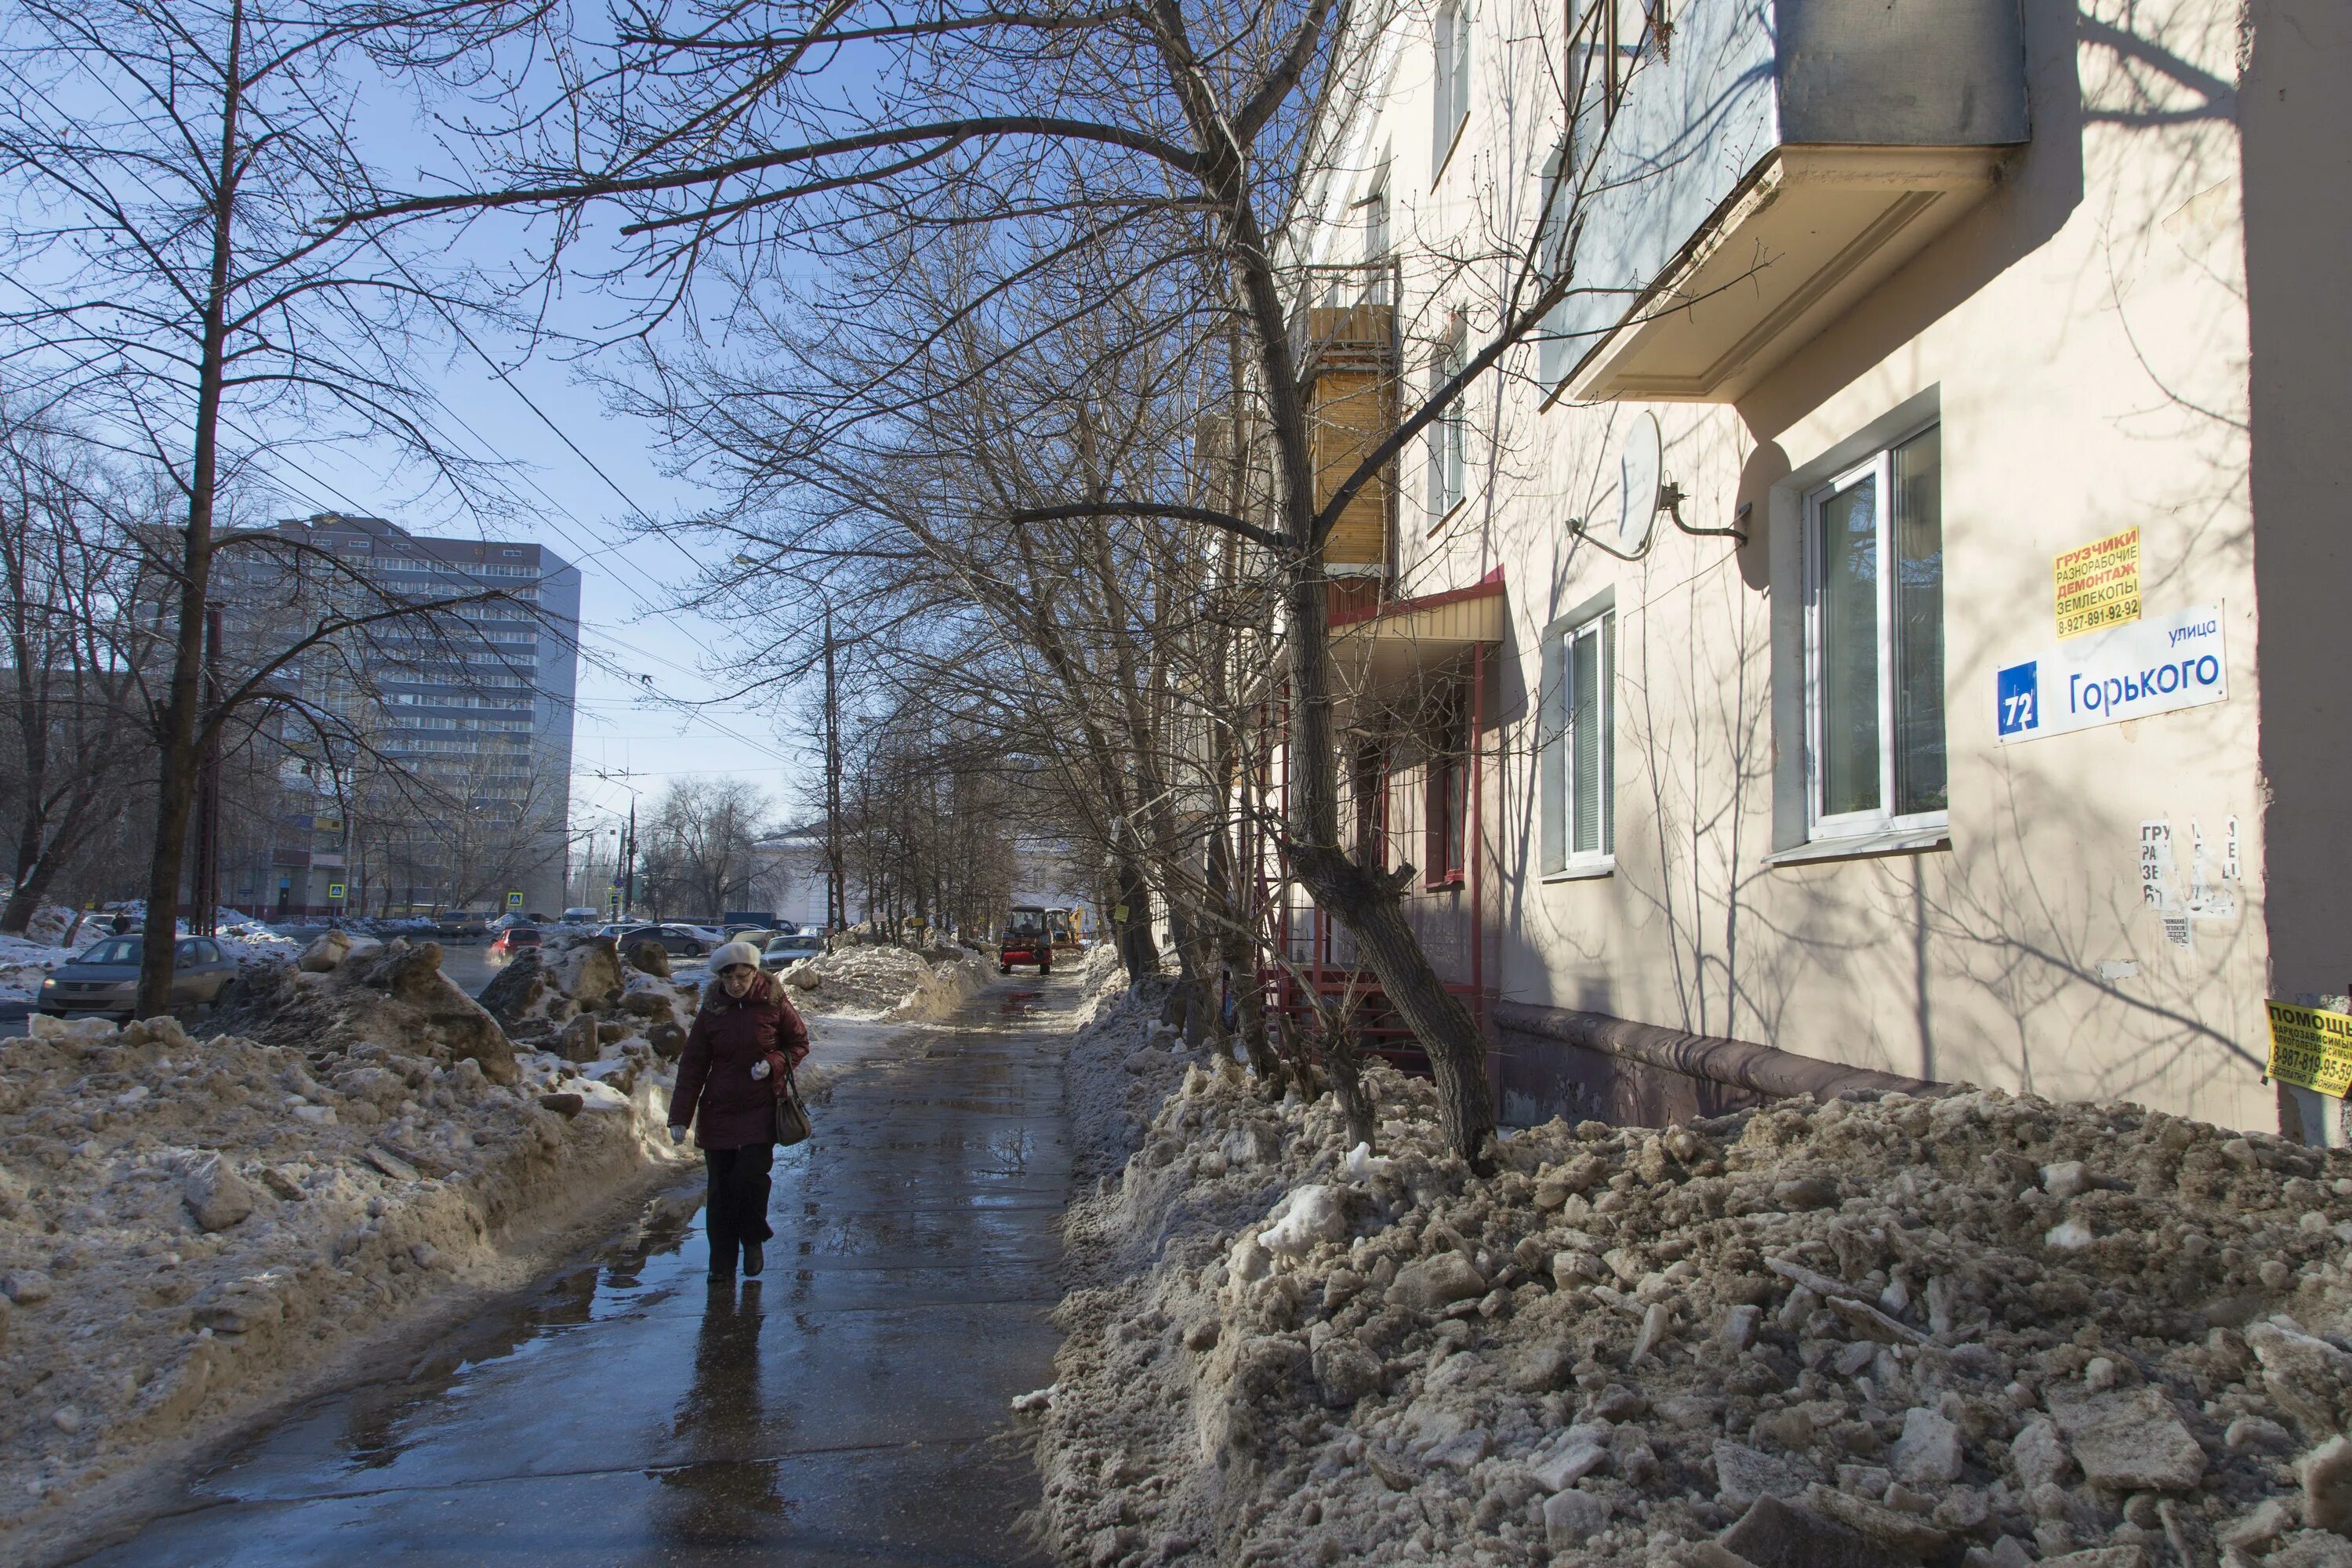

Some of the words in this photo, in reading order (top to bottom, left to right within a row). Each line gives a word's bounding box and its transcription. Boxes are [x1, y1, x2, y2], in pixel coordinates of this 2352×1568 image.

[2056, 530, 2136, 570] ГРУЗЧИКИ
[2056, 546, 2137, 583] РАЗНОРАБОЧИЕ
[2057, 561, 2136, 600] ДЕМОНТАЖ
[2057, 579, 2137, 615] ЗЕМЛЕКОПЫ
[2059, 599, 2139, 634] 8-927-891-92-92
[2168, 620, 2216, 648] улица
[2005, 693, 2033, 729] 72
[2070, 655, 2219, 717] Горького
[2269, 1065, 2307, 1083] БЕСПЛАТНО
[2308, 1076, 2347, 1094] АНОНИМНО
[2273, 1045, 2351, 1082] 8-987-819-95-59
